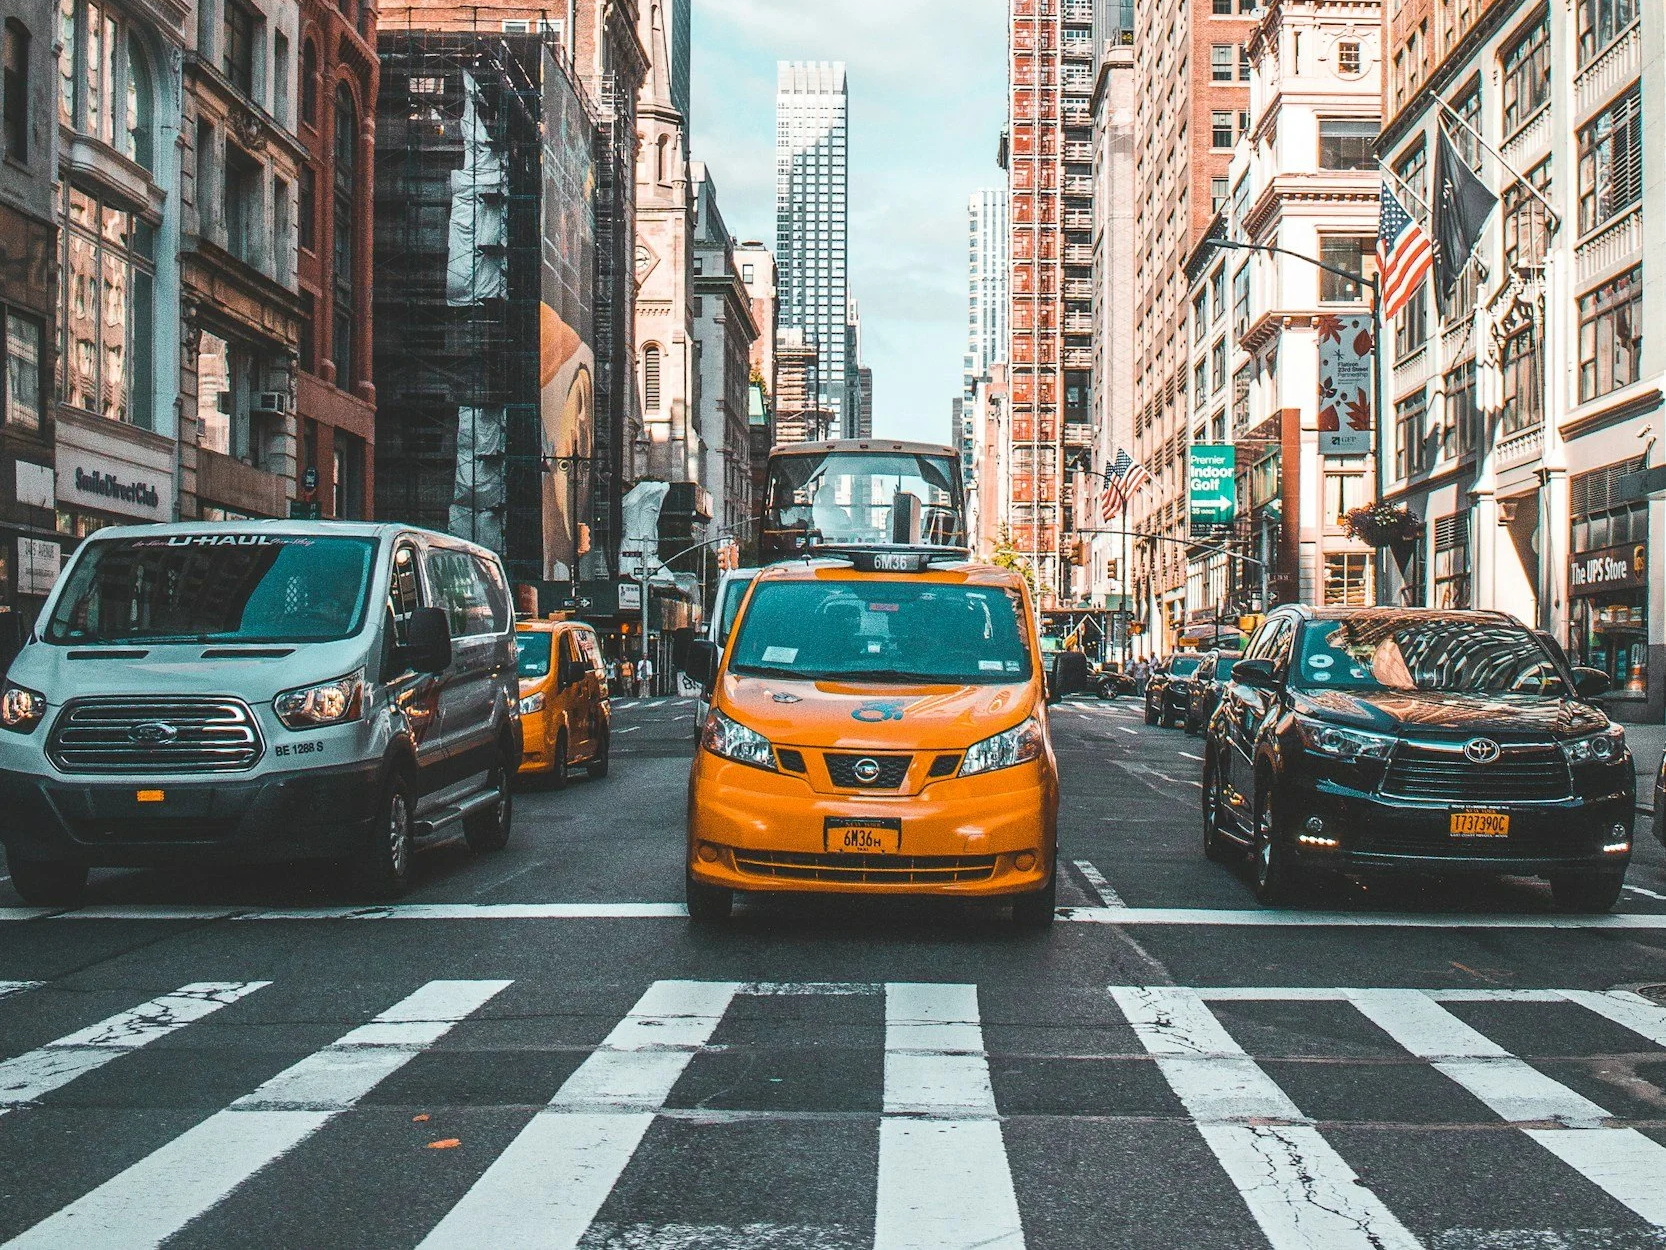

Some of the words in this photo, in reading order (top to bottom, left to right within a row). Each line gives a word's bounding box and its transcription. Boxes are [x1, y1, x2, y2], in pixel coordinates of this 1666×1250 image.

[1191, 455, 1225, 464] Premier
[1191, 466, 1234, 477] Indoor
[75, 466, 160, 508] SmileDirectClub
[1191, 478, 1219, 490] Golf
[168, 535, 271, 546] U-HAUL
[873, 554, 908, 570] 6M36
[1571, 562, 1586, 585] The
[1587, 558, 1603, 583] UPS
[1605, 556, 1627, 581] Store
[275, 745, 291, 757] BE
[292, 742, 315, 755] 1288
[316, 741, 324, 752] S
[1455, 815, 1505, 831] T737390C
[844, 830, 881, 847] 6M36H
